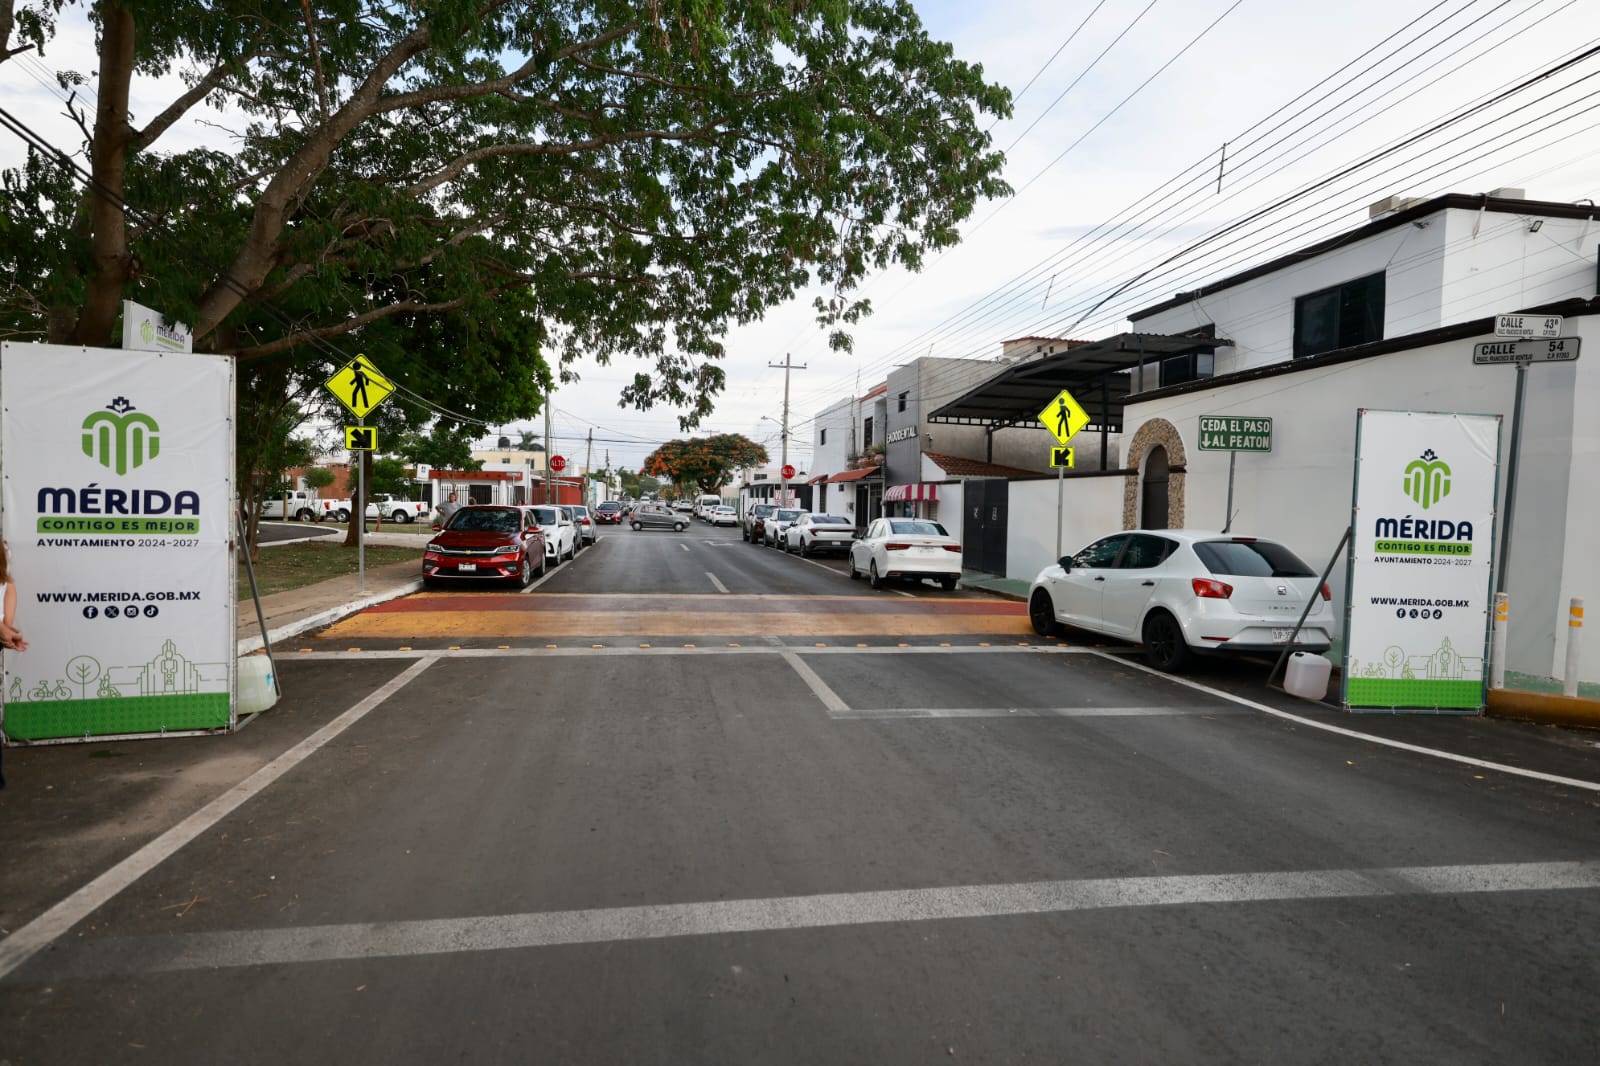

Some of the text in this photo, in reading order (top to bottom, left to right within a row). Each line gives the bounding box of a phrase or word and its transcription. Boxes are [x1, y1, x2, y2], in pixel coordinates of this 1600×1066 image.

[1501, 317, 1524, 328] CALLE
[1481, 341, 1564, 355] CALLE 54
[1201, 420, 1270, 433] CEDA EL PASO
[1212, 435, 1270, 448] AL PEATON
[781, 467, 794, 475] ALTO
[37, 483, 200, 515] MÉRIDA
[42, 520, 196, 532] CONTIGO ES MEJOR
[1375, 515, 1473, 541] MÉRIDA
[37, 538, 199, 547] AYUNTAMIENTO 2024-2027
[1377, 542, 1470, 554] CONTIGO ES MEJOR
[1374, 556, 1472, 566] AYUNTAMIENTO 2024-2027
[37, 591, 201, 602] WWW.MERIDA.GOB.MX
[1371, 597, 1470, 607] WWW.MERIDA.GOB.MX
